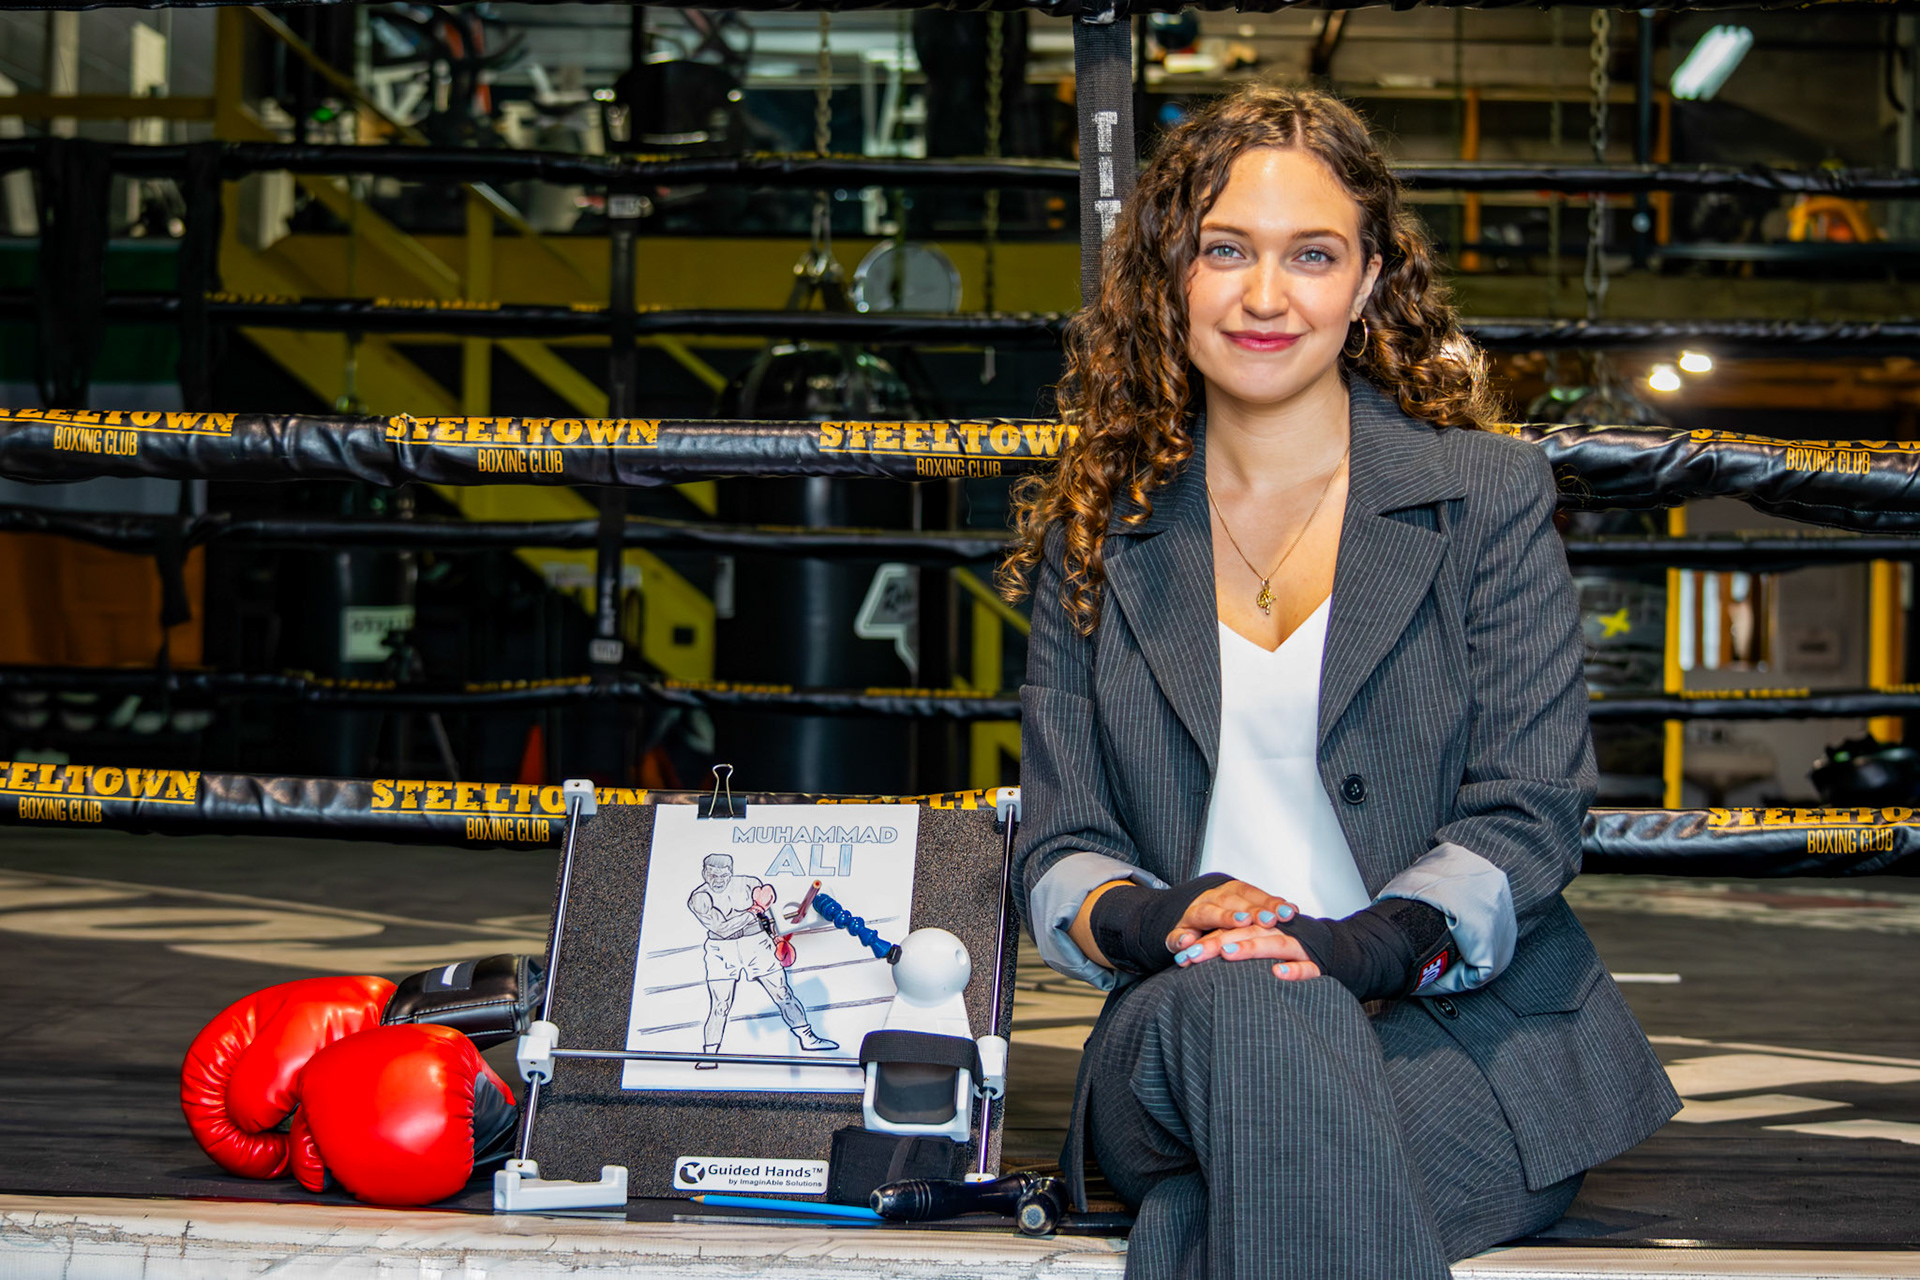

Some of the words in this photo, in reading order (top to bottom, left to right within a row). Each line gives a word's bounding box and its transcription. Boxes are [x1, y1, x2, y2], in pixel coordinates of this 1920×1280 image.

[1092, 111, 1122, 259] TIT
[53, 426, 102, 453] BOXING
[104, 428, 138, 456] CLUB
[386, 414, 661, 444] STEELTOWN
[478, 449, 527, 473] BOXING
[529, 450, 563, 473] CLUB
[916, 457, 965, 477] BOXING
[967, 459, 1002, 478] CLUB
[1786, 447, 1834, 473] BOXING
[1837, 450, 1870, 475] CLUB
[19, 796, 67, 821] BOXING
[69, 799, 102, 823] CLUB
[1708, 807, 1920, 826] STEELTO
[466, 817, 514, 841] BOXING
[516, 819, 550, 842] CLUB
[732, 826, 898, 844] MUHAMMAD
[1807, 829, 1857, 854] BOXING
[1860, 828, 1894, 852] CLUB
[764, 844, 853, 877] ALI
[708, 1164, 760, 1176] Guided
[728, 1178, 738, 1186] by
[740, 1179, 784, 1187] ImaginAble
[785, 1179, 822, 1188] Solutions
